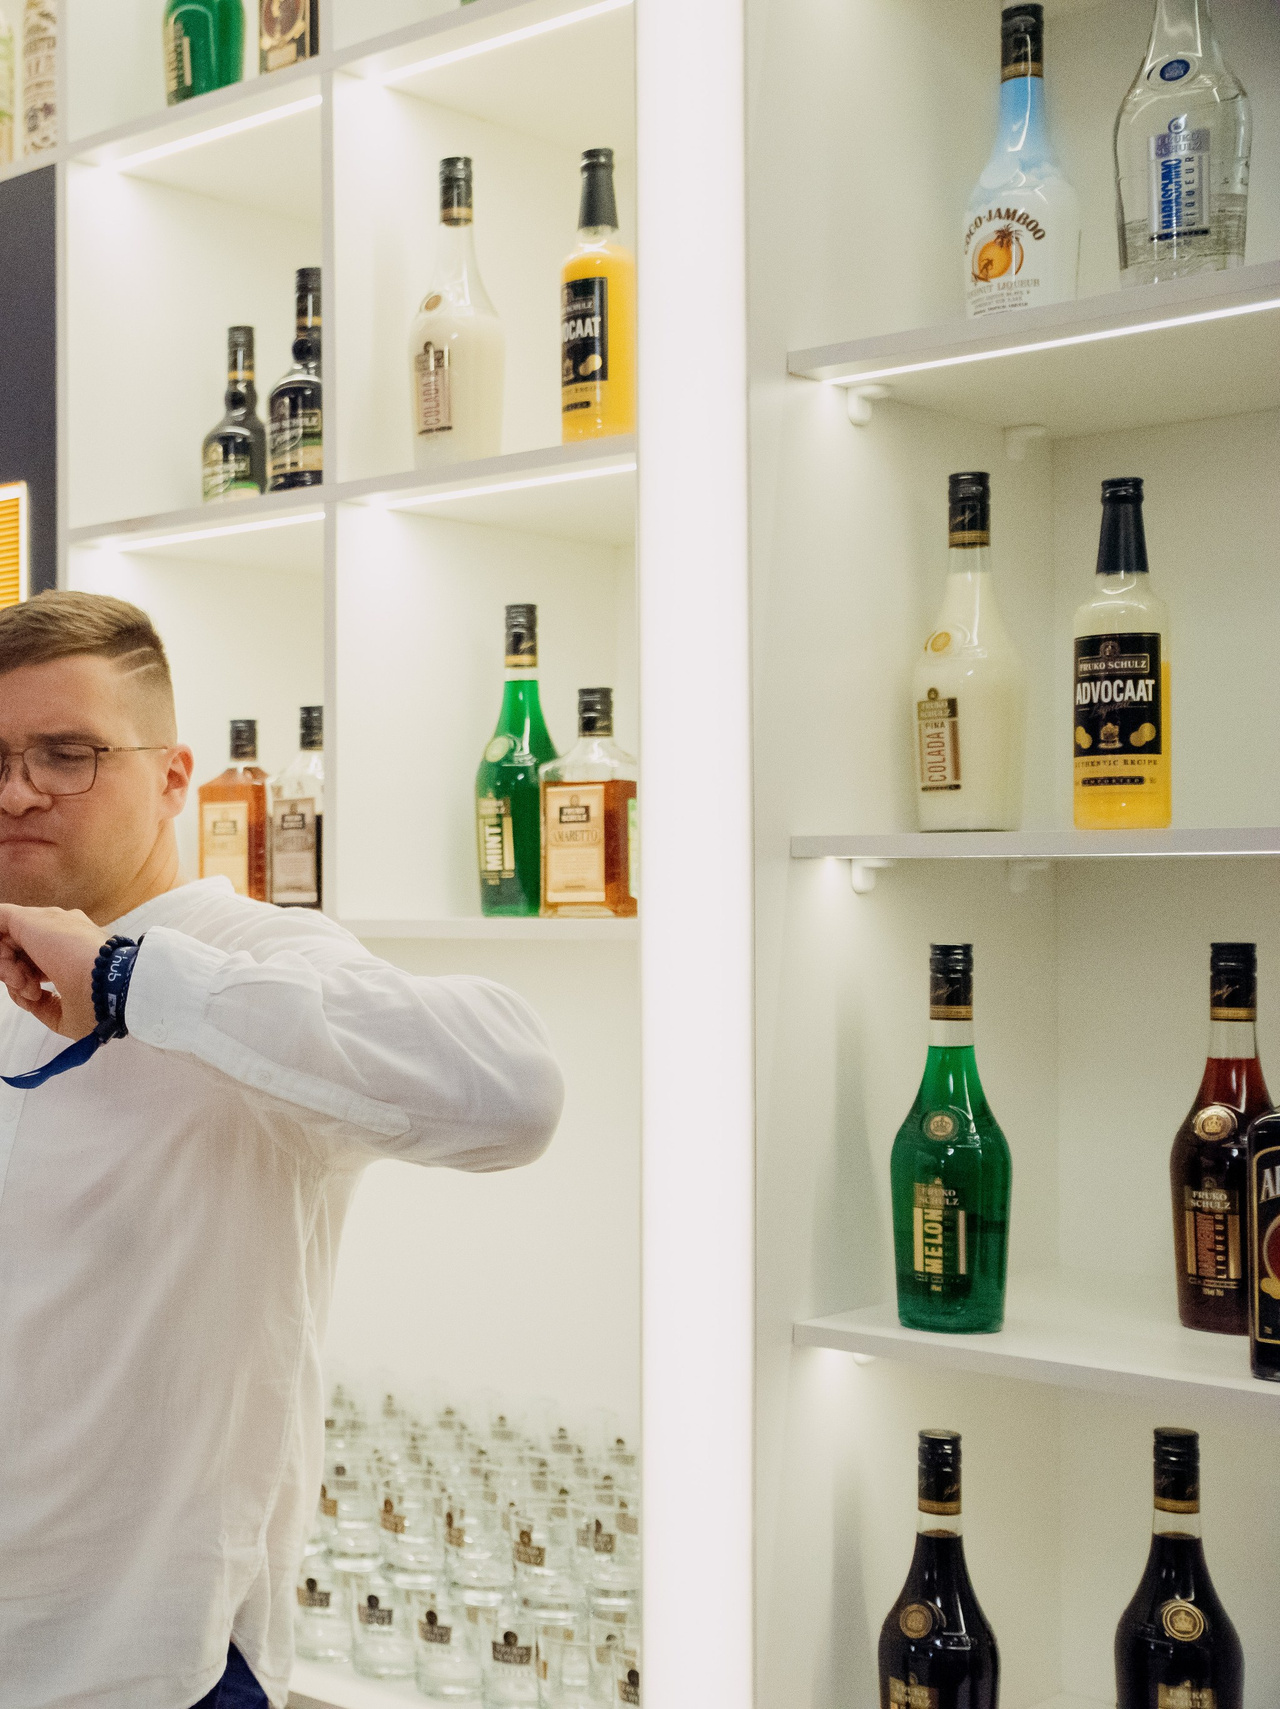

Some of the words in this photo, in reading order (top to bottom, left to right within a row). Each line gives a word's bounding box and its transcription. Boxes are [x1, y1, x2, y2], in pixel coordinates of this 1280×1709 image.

[562, 316, 601, 342] OCAAT
[1108, 660, 1147, 670] SCHULZ
[1075, 679, 1156, 705] ADVOCAAT
[926, 731, 947, 782] COLADA
[485, 825, 503, 870] MINT
[1190, 1200, 1232, 1210] SCHULZ
[1192, 1190, 1228, 1201] FRUKO
[924, 1209, 943, 1274] MELON
[1214, 1213, 1227, 1280] LIQUEUR
